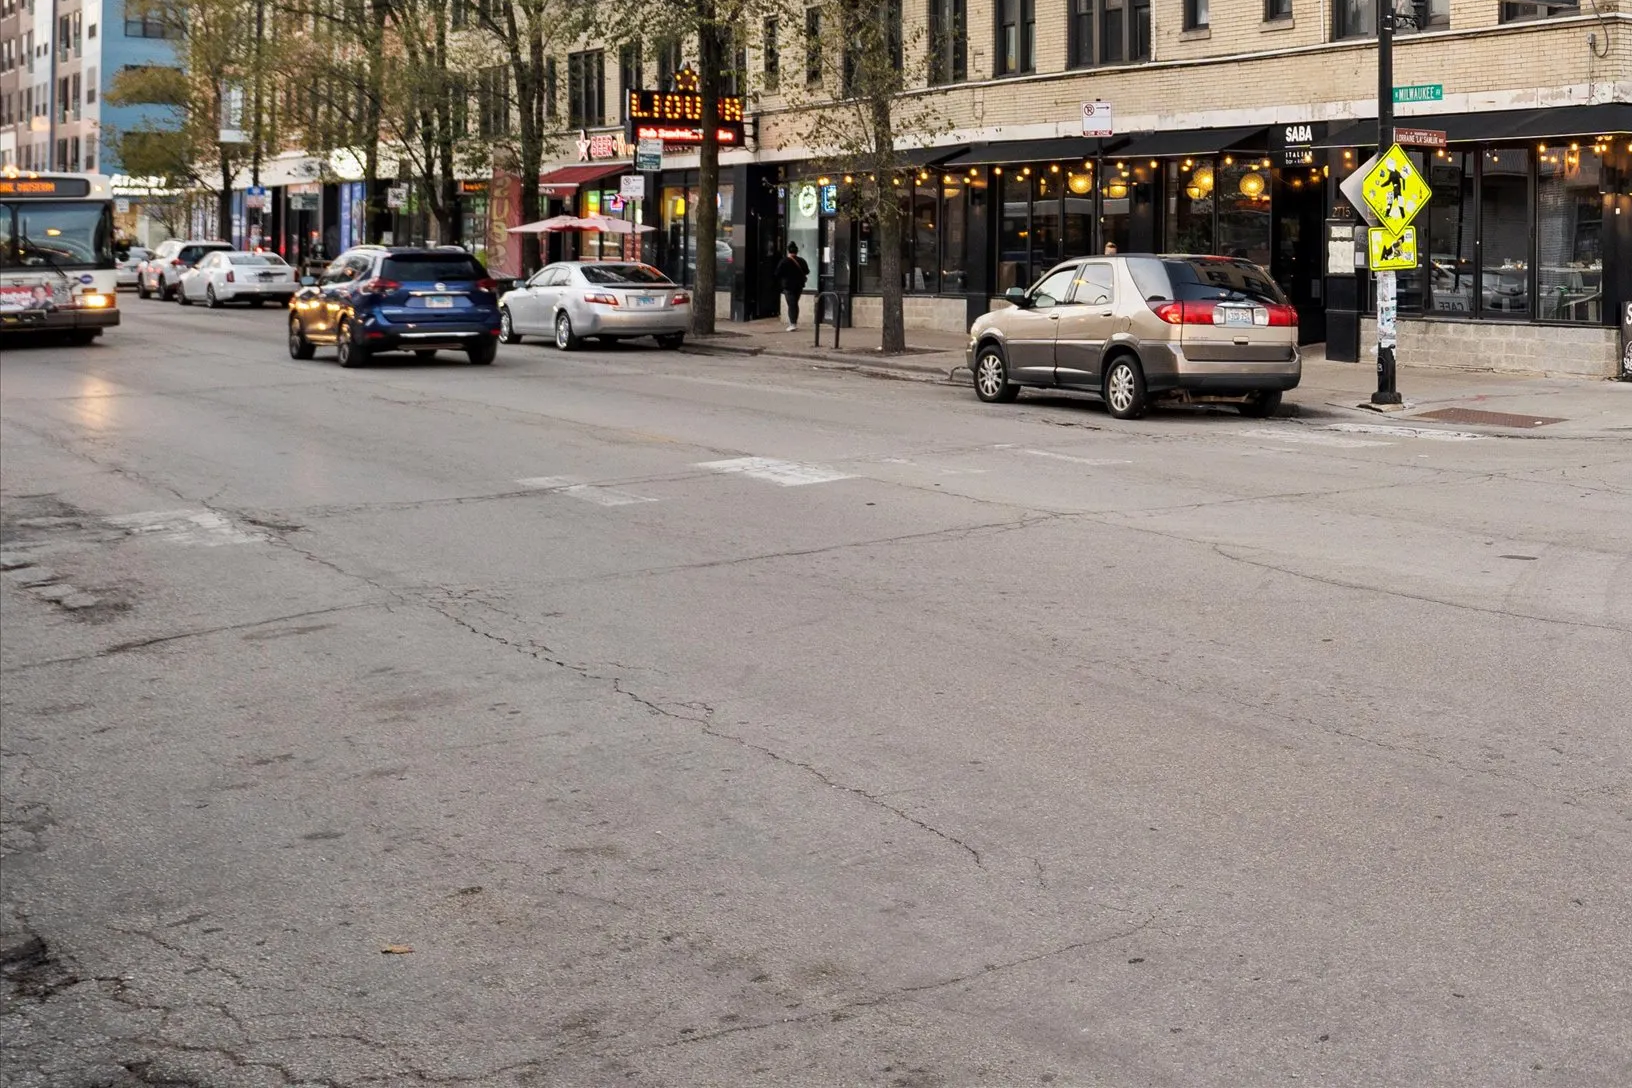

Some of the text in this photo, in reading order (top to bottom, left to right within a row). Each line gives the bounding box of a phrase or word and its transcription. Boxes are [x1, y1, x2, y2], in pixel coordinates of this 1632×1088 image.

[1398, 86, 1435, 101] MILWAUKEE
[631, 92, 743, 121] LIQUR
[1285, 125, 1313, 143] SABA
[1285, 151, 1313, 159] ITALIAN
[1332, 206, 1351, 218] 2715
